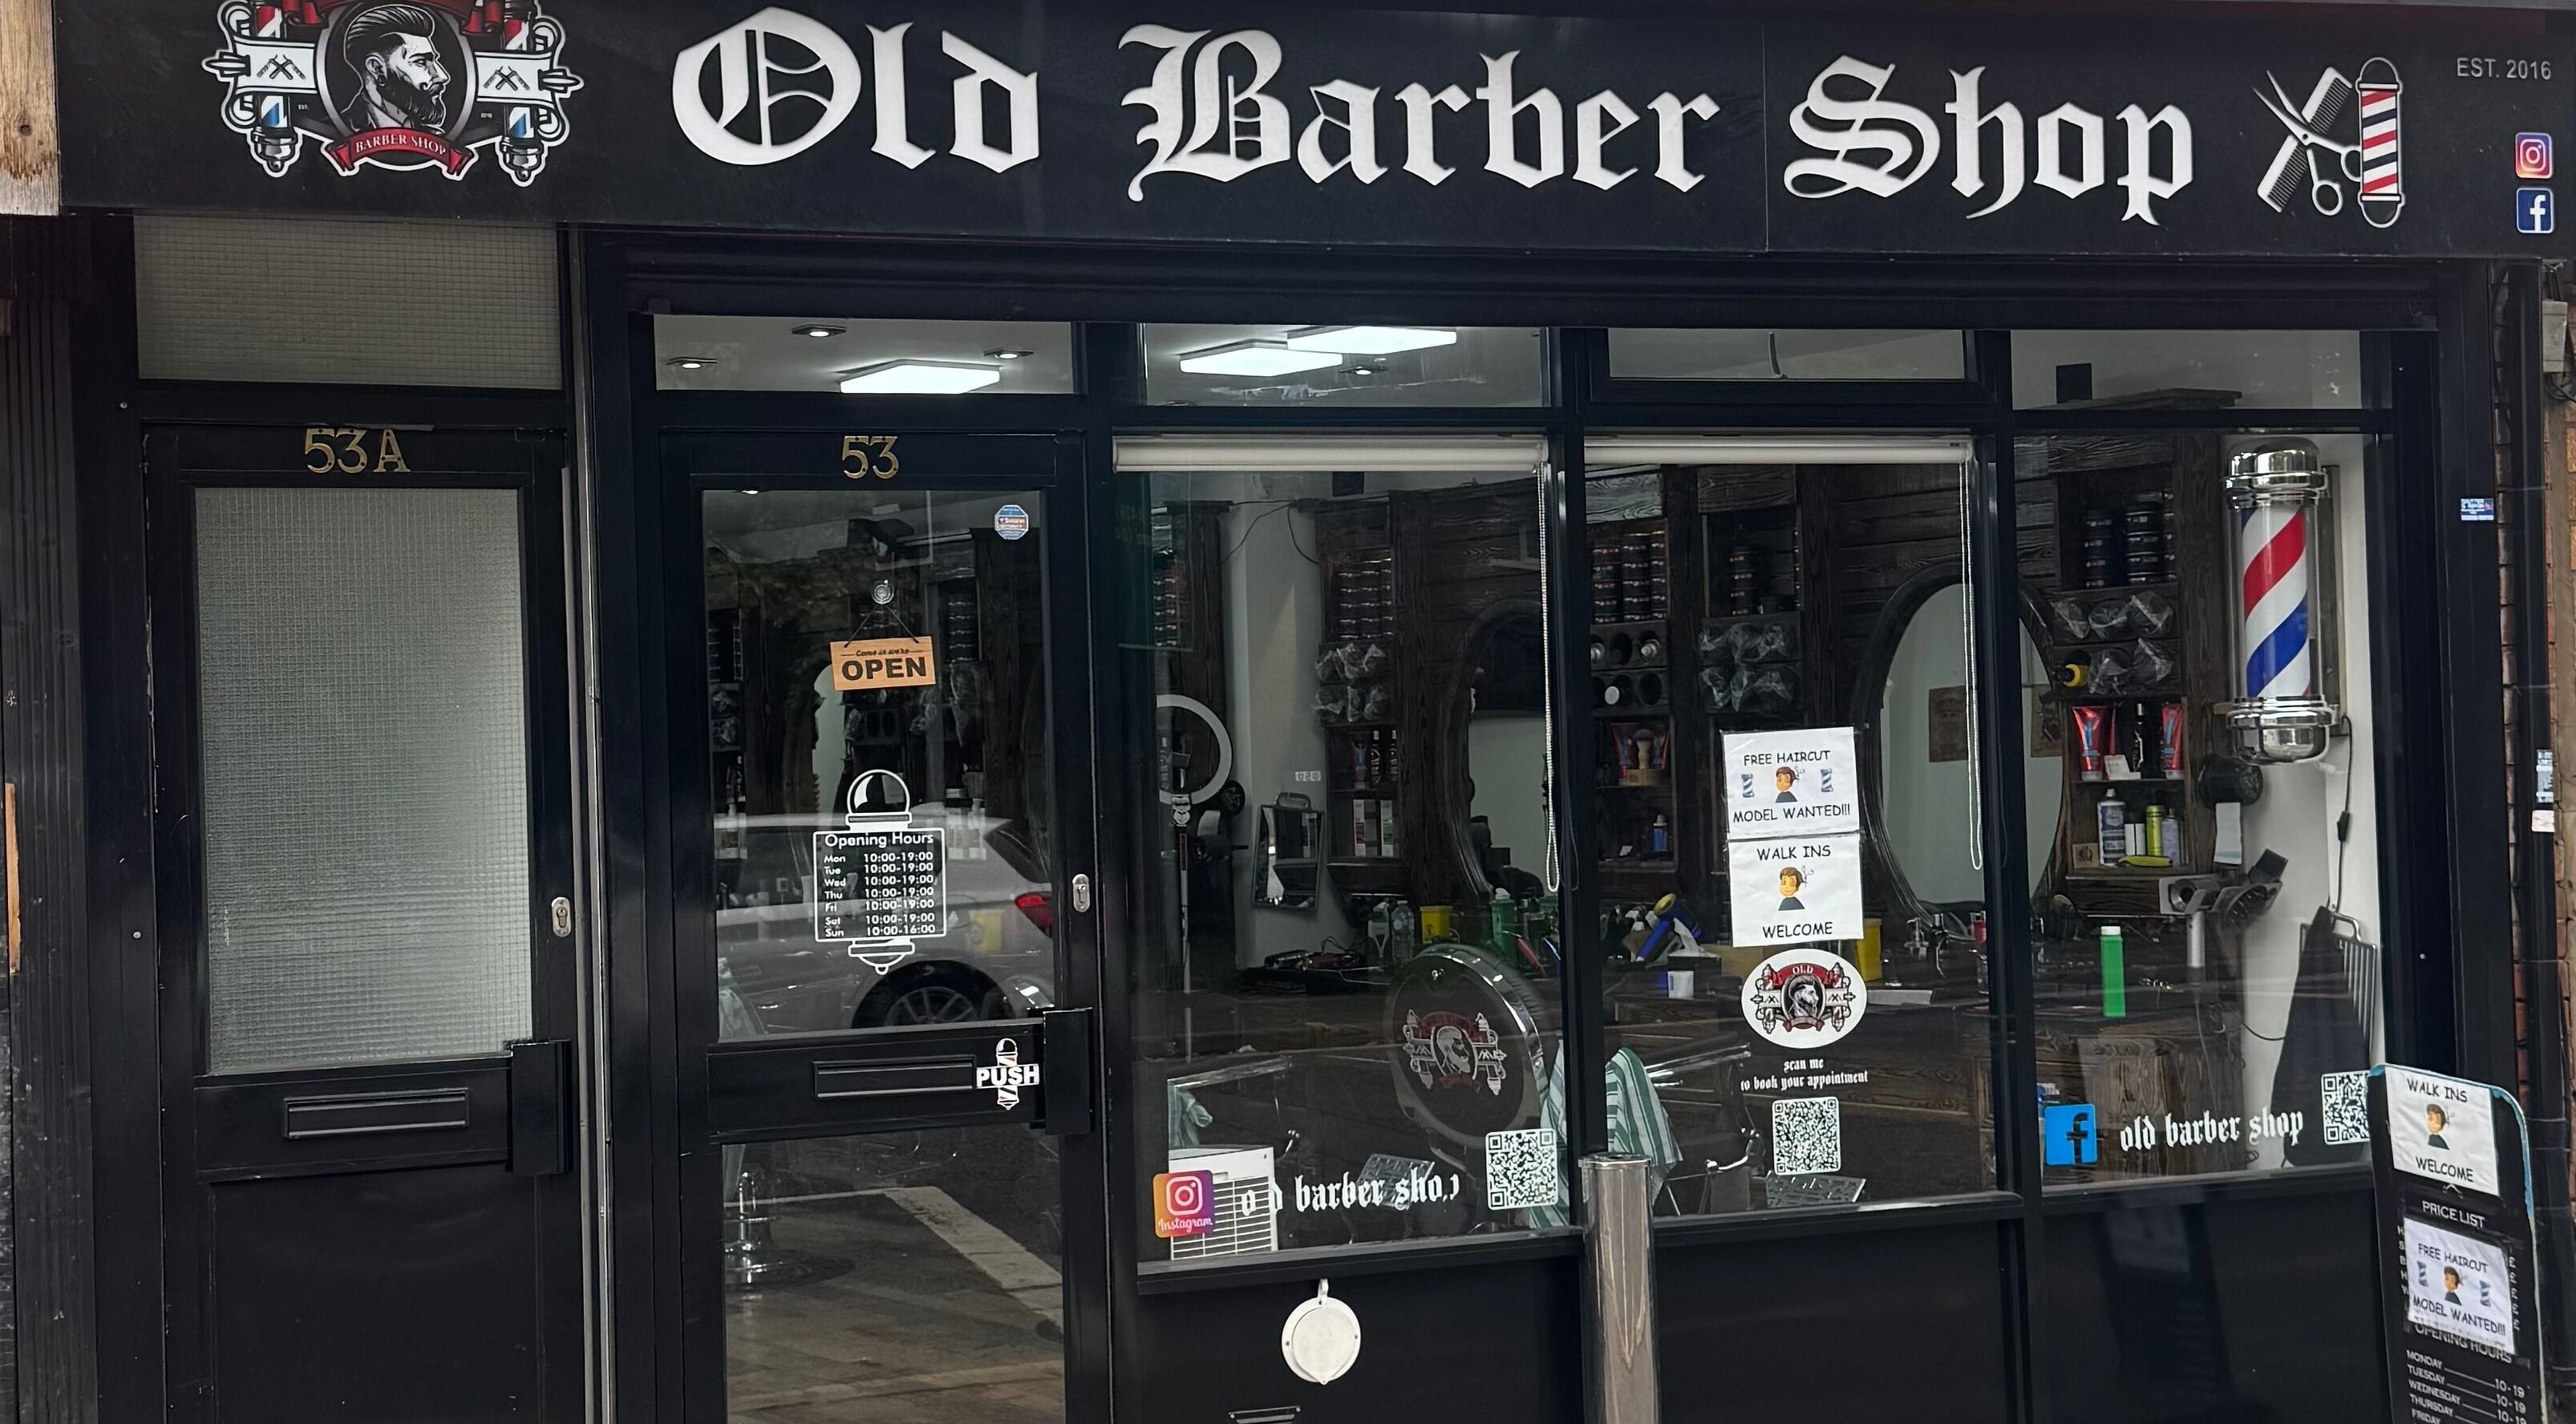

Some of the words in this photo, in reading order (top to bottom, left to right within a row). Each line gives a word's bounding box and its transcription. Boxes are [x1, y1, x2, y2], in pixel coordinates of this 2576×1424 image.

[2457, 57, 2500, 79] EST.
[2506, 59, 2552, 80] 2016
[672, 6, 1039, 174] Old
[1119, 23, 1721, 202] Barber
[1783, 54, 2193, 227] Shop
[354, 133, 408, 154] BARBER
[411, 133, 446, 156] SHOP
[840, 435, 900, 479] 53
[841, 656, 927, 682] OPEN
[1744, 753, 1772, 766] FREE
[1776, 750, 1831, 763] HAIRCUT
[1732, 808, 1778, 823] MODEL
[1783, 803, 1851, 819] WANTED!!!
[825, 832, 887, 849] Opening
[892, 831, 934, 846] Hours
[824, 855, 846, 864] Mon
[865, 852, 934, 863] 10:00-19:00
[1756, 846, 1796, 860] WALK
[1802, 844, 1832, 858] INS
[824, 867, 841, 875] Tue
[865, 862, 934, 874] 10:00-19:00
[824, 877, 847, 887] Wed
[865, 874, 934, 886] 10:00-19:00
[824, 891, 843, 900] Thu
[865, 887, 934, 898] 10:00-19:00
[824, 903, 837, 912] Fri
[865, 899, 935, 911] 10:00-19:00
[824, 916, 841, 925] Sat
[866, 912, 935, 924] 10:00-19:00
[824, 928, 844, 937] Sun
[867, 924, 936, 937] 10:00-16:00
[1762, 921, 1834, 939] WELCOME
[1792, 964, 1814, 976] OLD
[977, 1065, 1039, 1087] PUSH
[1783, 1059, 1807, 1074] scan
[1809, 1058, 1825, 1070] me
[1753, 1074, 1778, 1090] book
[1780, 1076, 1804, 1091] your
[1807, 1070, 1869, 1090] appointment
[2407, 1078, 2440, 1097] WALK
[2444, 1086, 2468, 1102] INS
[2120, 1115, 2157, 1152] old
[2165, 1110, 2241, 1148] barber
[2249, 1104, 2303, 1147] shop
[2416, 1156, 2475, 1183] WELCOME
[1294, 1171, 1386, 1213] barber
[2422, 1200, 2457, 1222] PRICE
[2459, 1209, 2486, 1228] LIST
[1158, 1217, 1213, 1233] Instagram
[2418, 1243, 2441, 1260] FREE
[2444, 1252, 2488, 1273] HAIRCUT
[2413, 1294, 2448, 1317] MODEL
[2450, 1307, 2506, 1337] WANTED!!!
[2415, 1324, 2469, 1349] OPENING
[2470, 1342, 2513, 1364] HOURS
[2406, 1349, 2443, 1369] MONDAY
[2408, 1364, 2445, 1385] TUESDAY
[2408, 1379, 2461, 1406] WEDNESDAY
[2409, 1394, 2454, 1417] THURSDAY
[2412, 1408, 2441, 1424] FRIDAY
